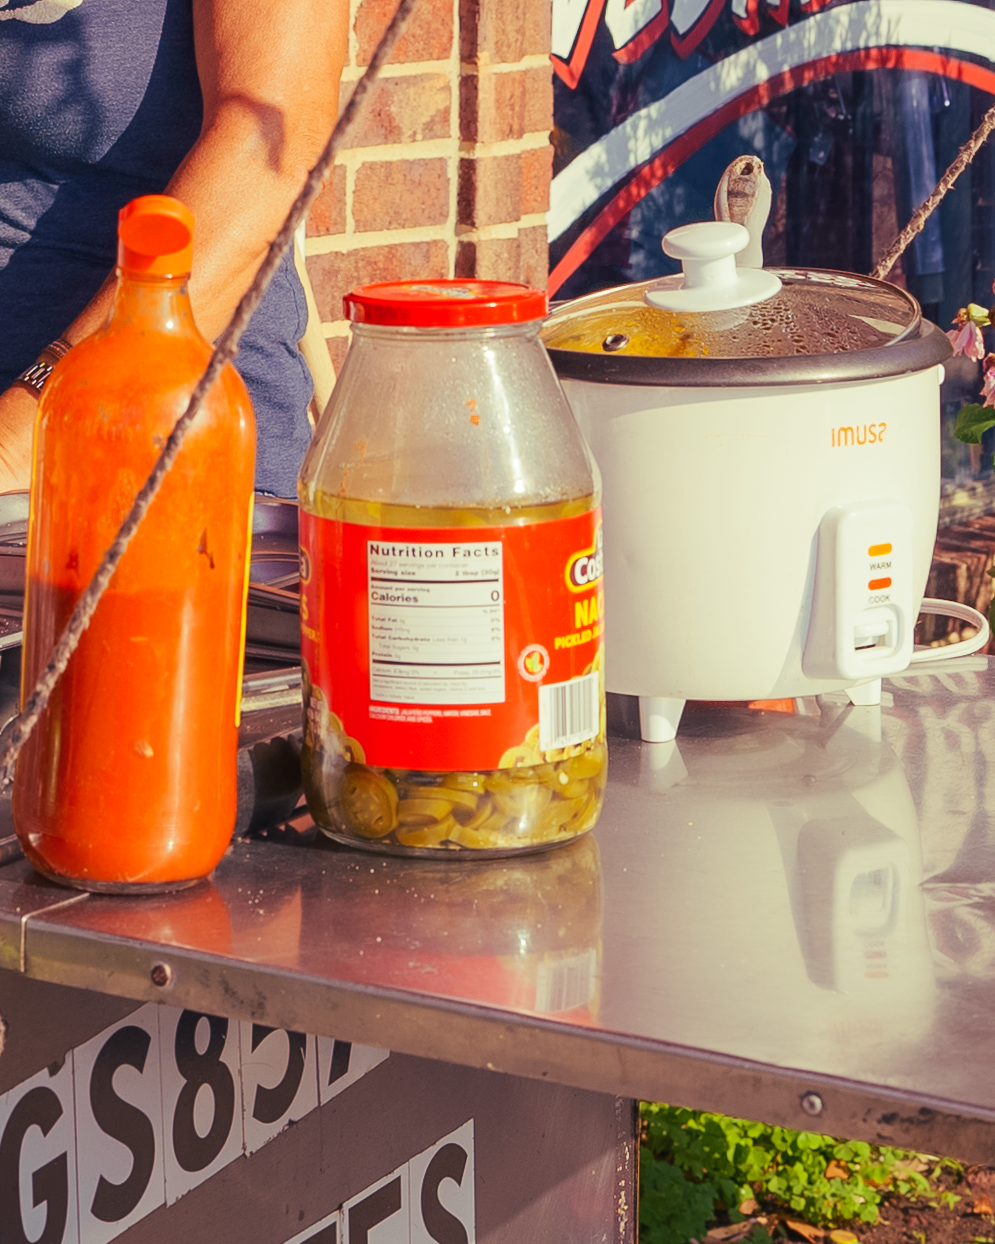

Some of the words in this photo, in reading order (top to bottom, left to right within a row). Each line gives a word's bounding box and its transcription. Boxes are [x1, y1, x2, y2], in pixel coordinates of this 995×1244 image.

[370, 544, 444, 558] Nutrition
[452, 546, 499, 558] Facts
[870, 561, 892, 570] WARM
[371, 591, 418, 604] Calories
[490, 590, 500, 602] 0
[869, 594, 891, 604] COOK
